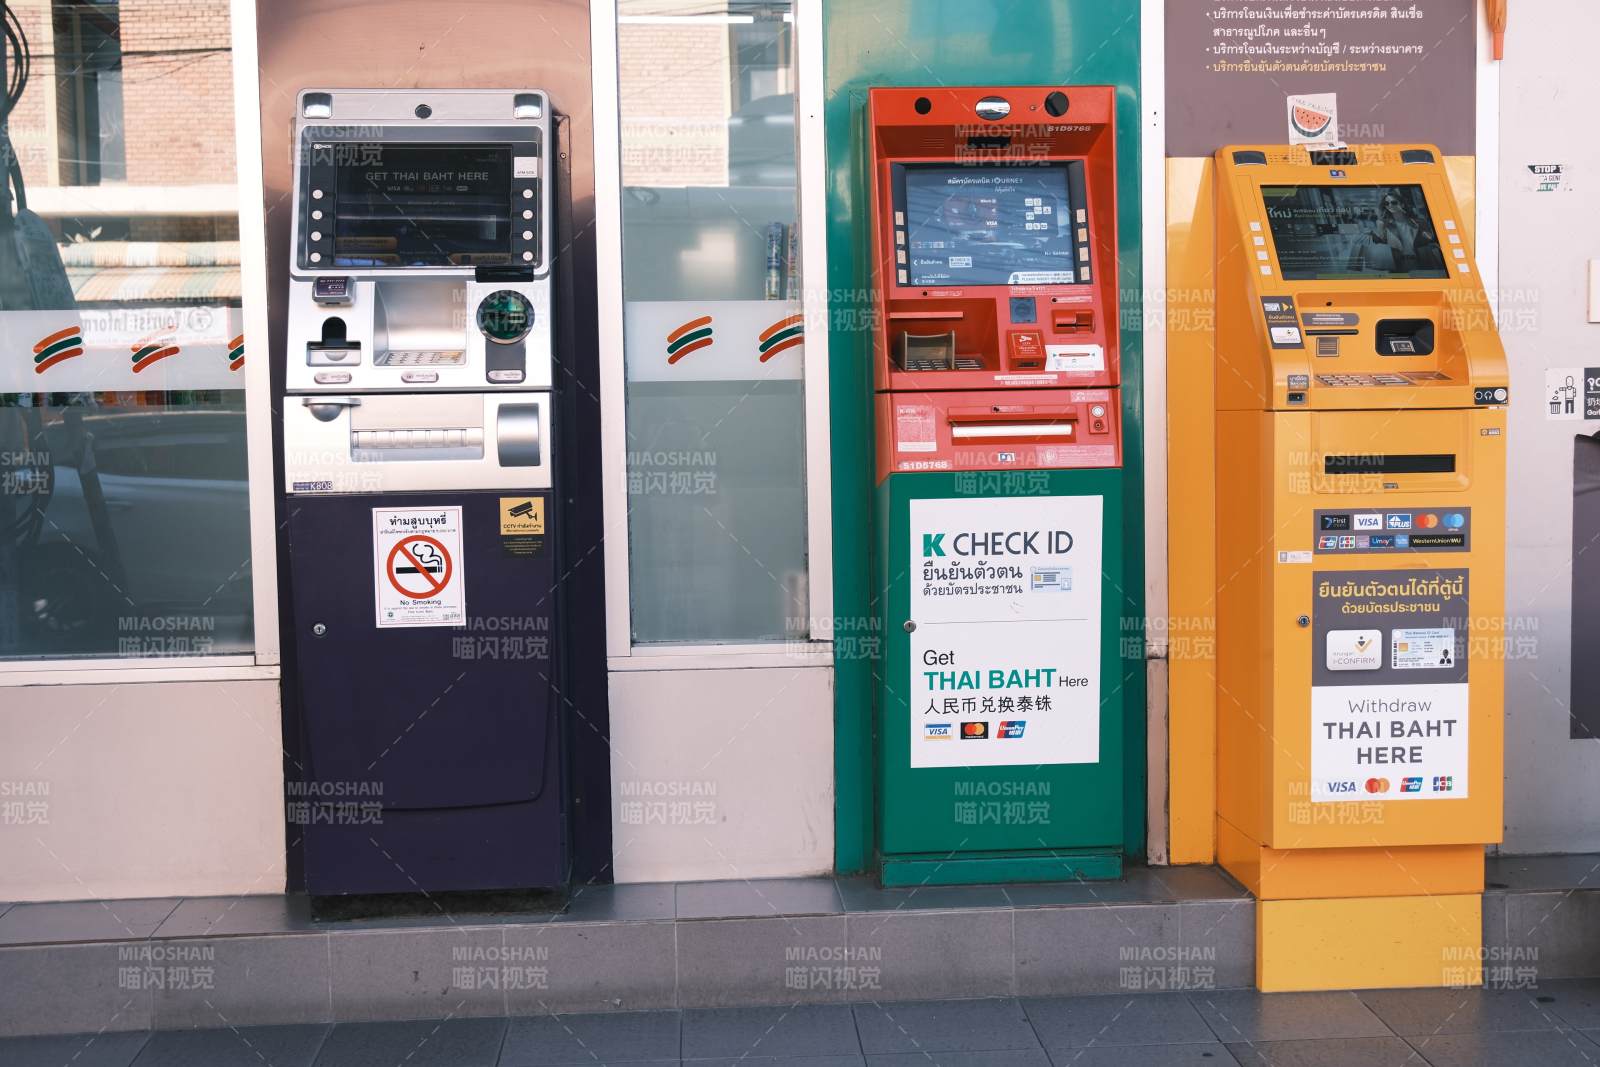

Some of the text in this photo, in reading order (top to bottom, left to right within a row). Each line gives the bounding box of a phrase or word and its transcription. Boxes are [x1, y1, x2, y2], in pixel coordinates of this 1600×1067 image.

[365, 172, 489, 181] GET THAI BAHT HERE
[1534, 165, 1557, 173] STOP
[1333, 517, 1346, 525] First
[1358, 518, 1379, 527] VISA
[923, 530, 1074, 557] K CHECK ID
[923, 560, 1023, 581] ยืนยันตัวตน
[923, 583, 1023, 597] ด้วยบัตรประชาชน
[1319, 576, 1464, 600] ยืนยันตัวตนได้ที่ตู้นี้
[412, 599, 442, 607] Smoking
[1341, 602, 1440, 614] ด้วยบัตรประชาชน
[923, 650, 955, 666] Get
[924, 668, 1089, 691] THAI BAHT Here
[924, 694, 1053, 715] 人民币兑换泰铢
[1348, 698, 1432, 713] Withdraw
[1323, 719, 1457, 740] THAI BAHT
[1357, 746, 1423, 765] HERE
[1327, 782, 1357, 793] VISA
